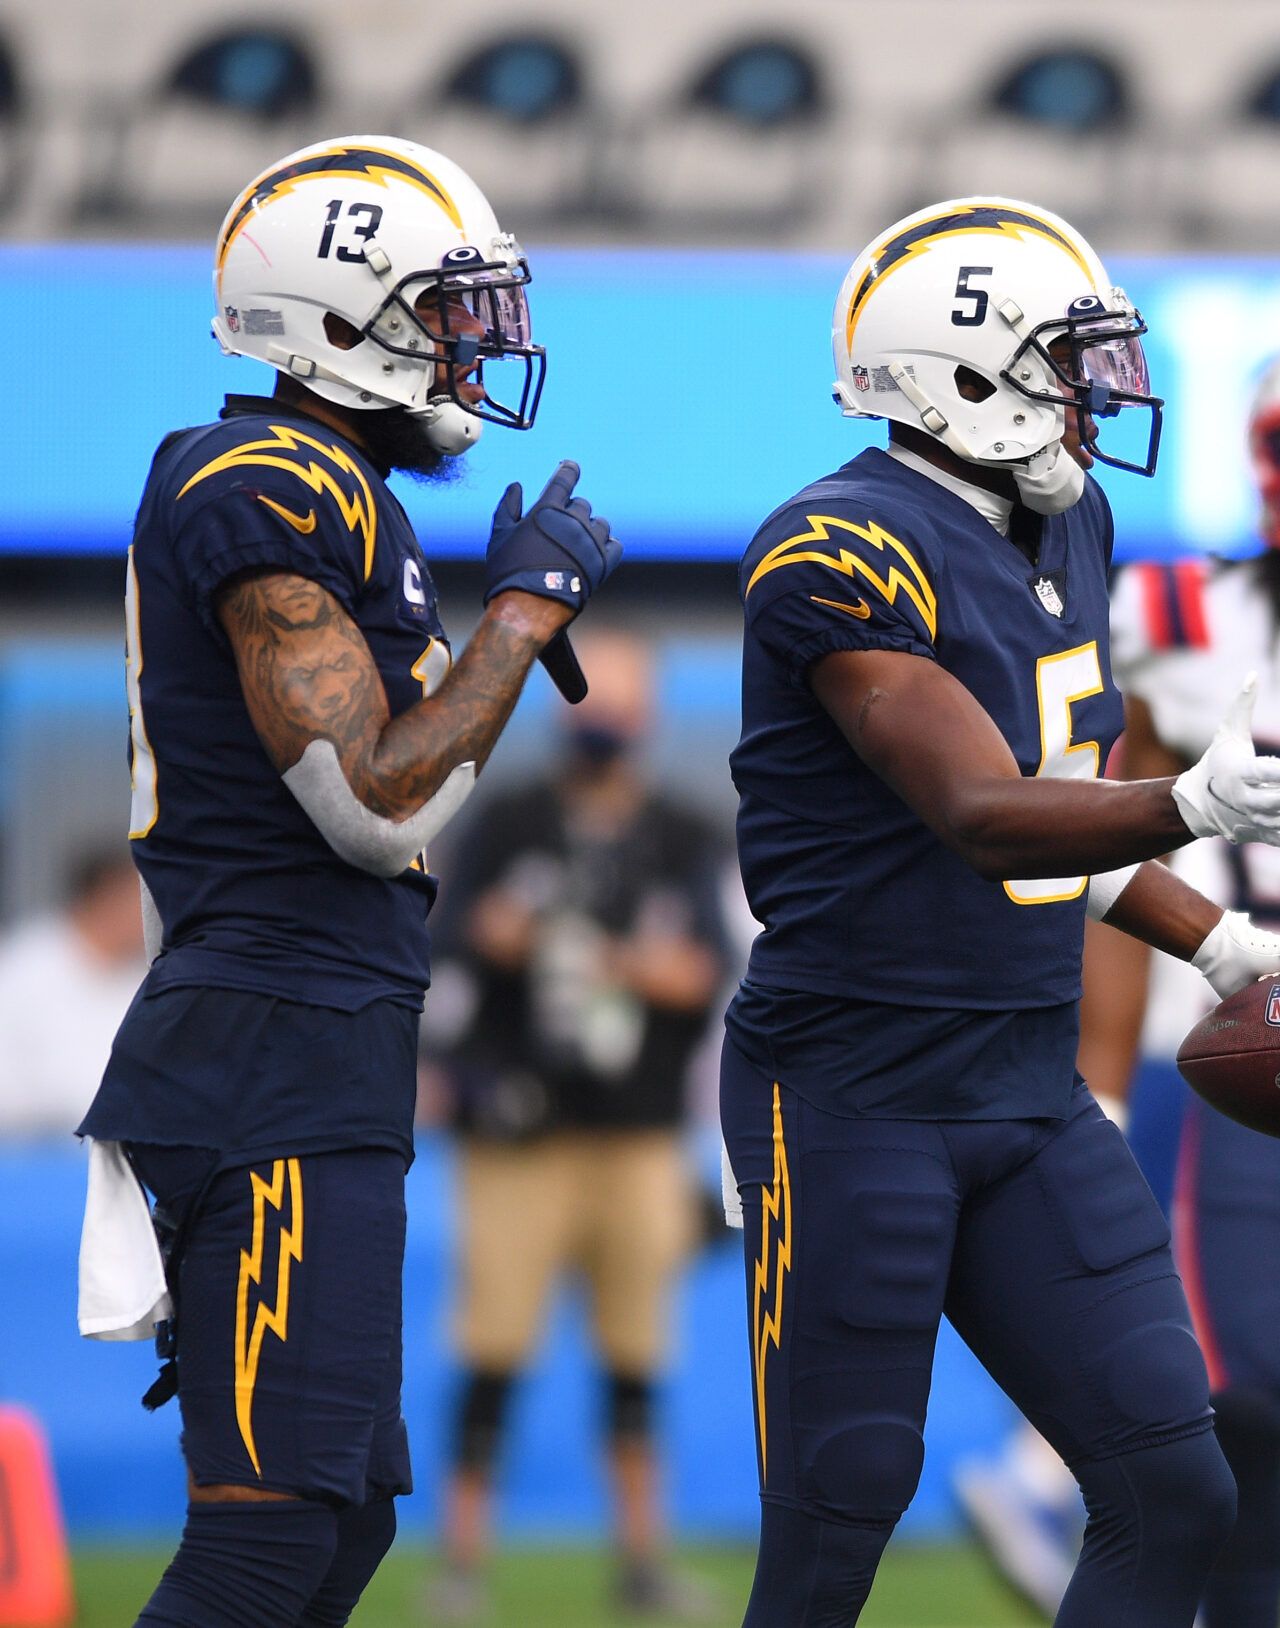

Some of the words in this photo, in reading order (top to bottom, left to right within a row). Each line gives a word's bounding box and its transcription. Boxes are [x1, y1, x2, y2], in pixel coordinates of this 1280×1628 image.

[317, 199, 383, 264] 13
[951, 266, 993, 327] 5
[403, 558, 426, 606] C
